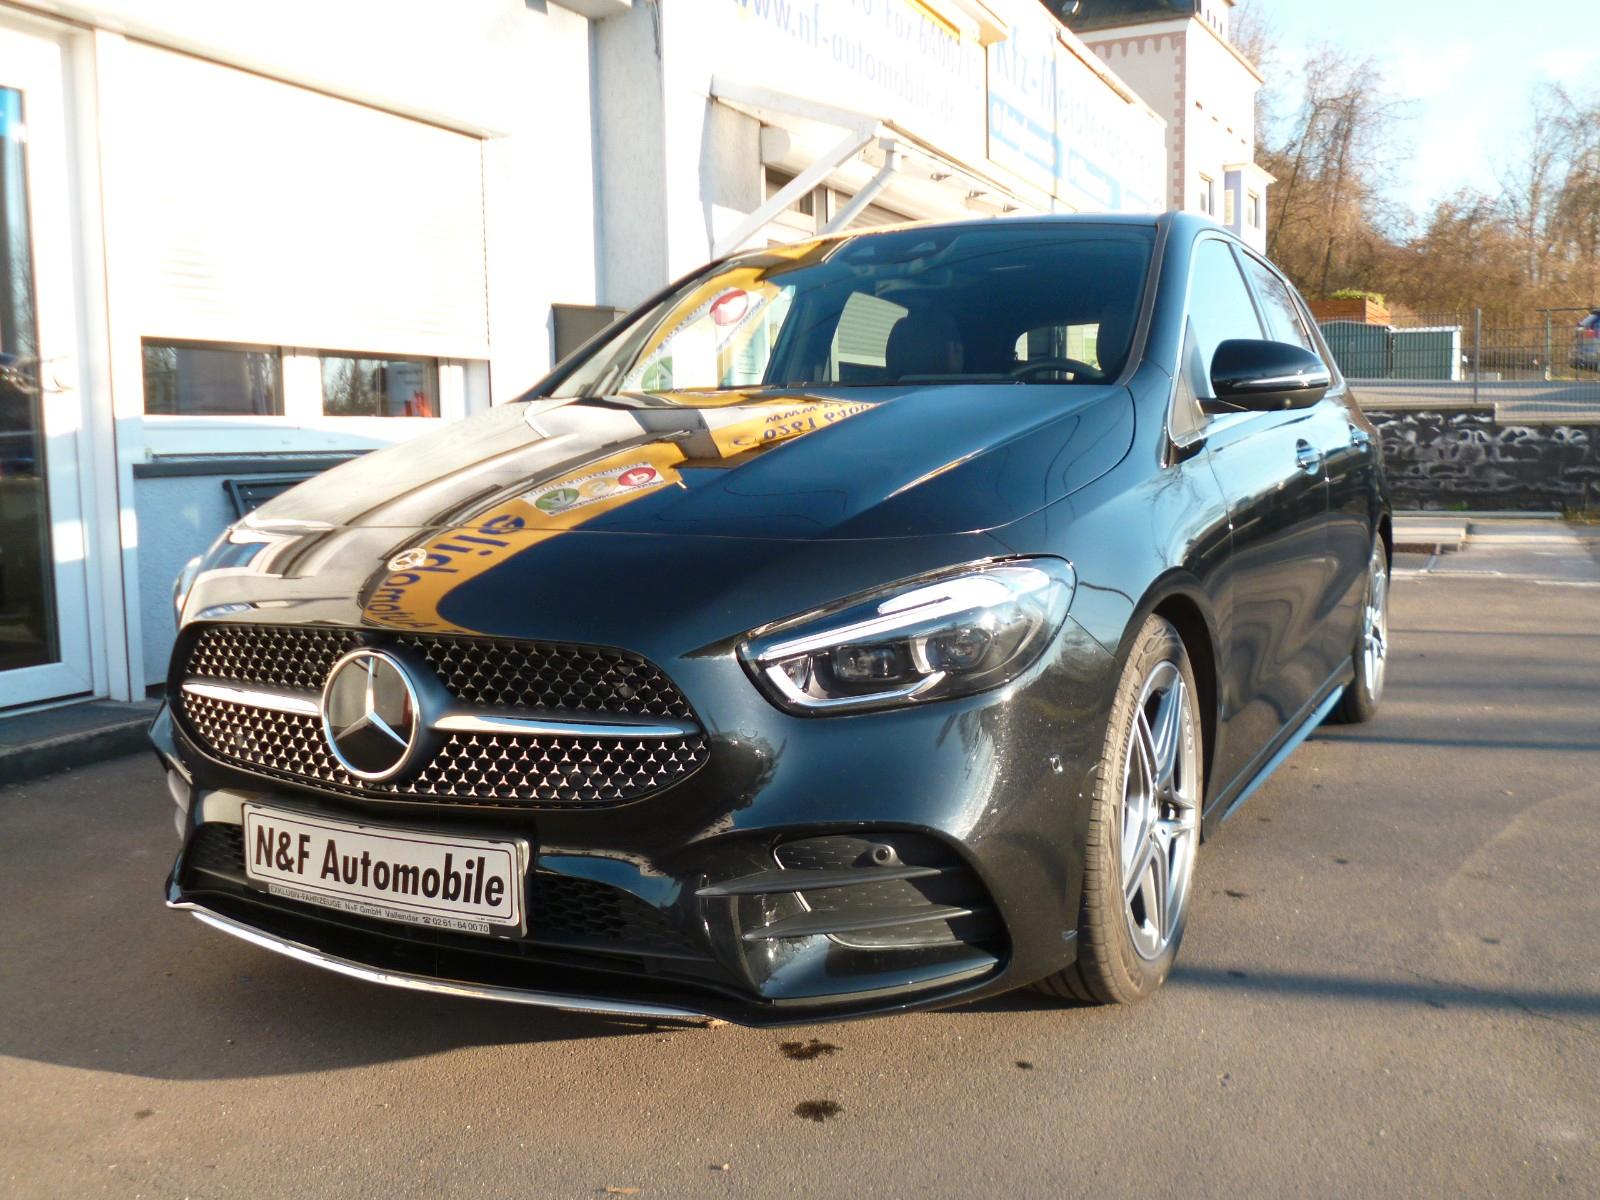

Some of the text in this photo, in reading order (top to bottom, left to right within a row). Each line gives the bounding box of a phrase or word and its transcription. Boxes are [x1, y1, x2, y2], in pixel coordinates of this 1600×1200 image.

[255, 824, 505, 907] N&F Automobile
[359, 905, 382, 917] GmbH
[385, 909, 419, 923] Vallendar
